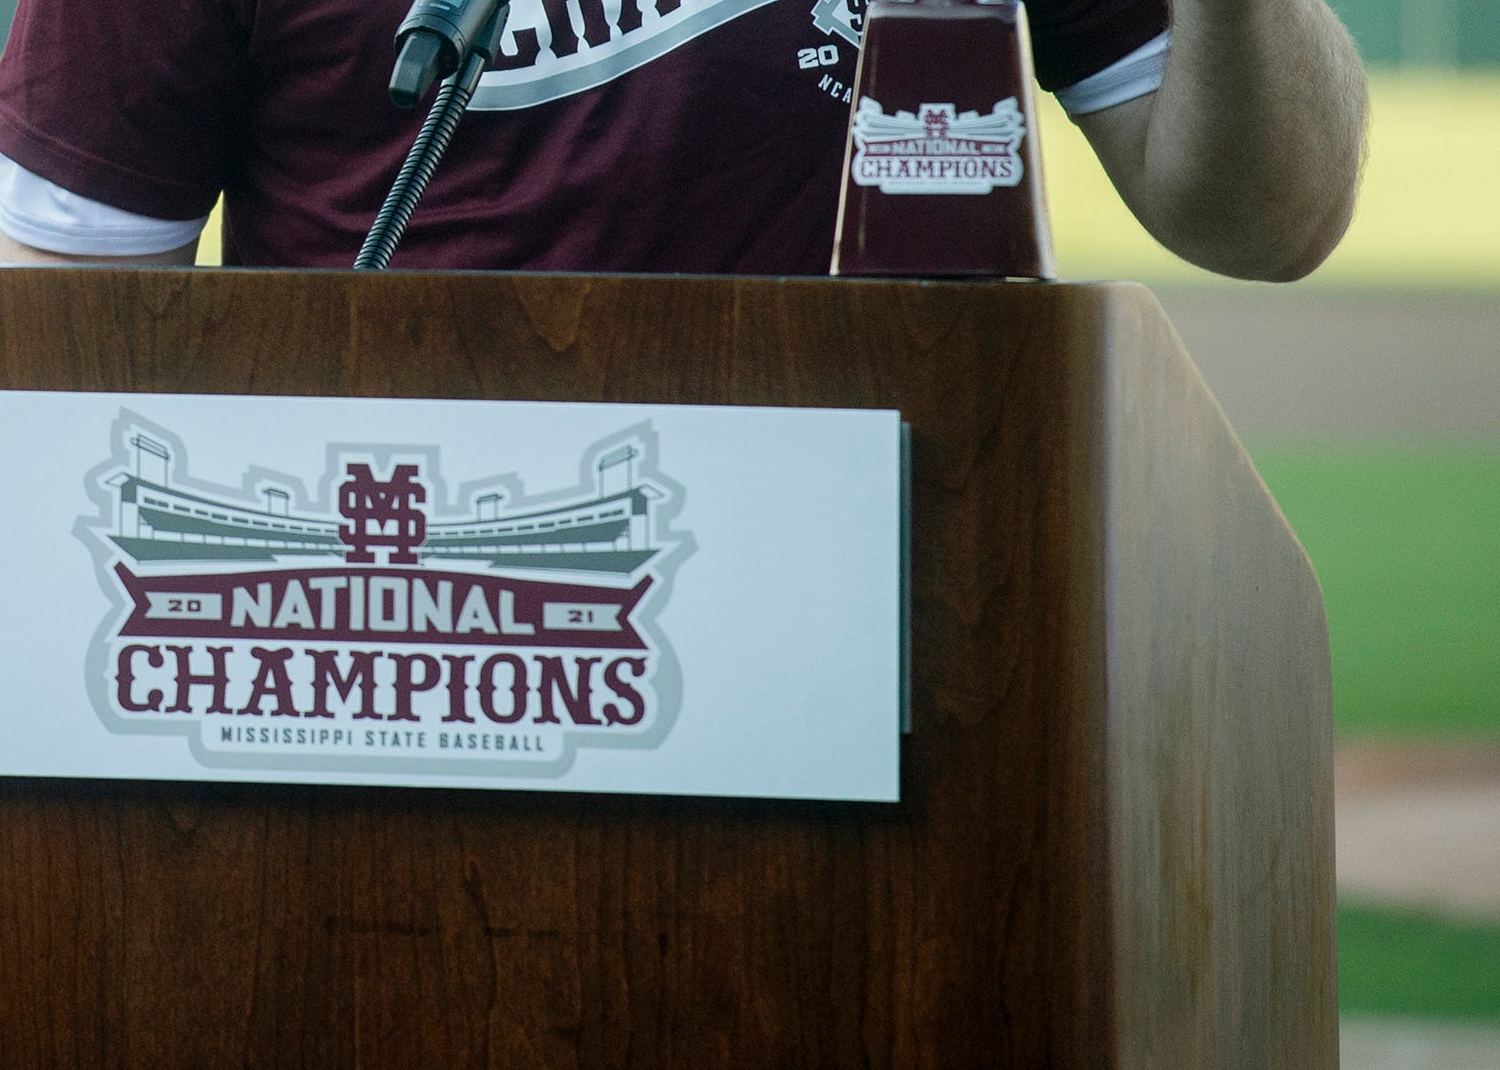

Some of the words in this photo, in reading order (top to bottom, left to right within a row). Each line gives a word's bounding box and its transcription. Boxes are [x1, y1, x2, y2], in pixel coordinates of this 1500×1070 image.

[797, 44, 840, 70] 20
[818, 74, 853, 104] NCA
[892, 139, 981, 155] NATIONAL
[861, 159, 1012, 179] CHAMPIONS
[168, 599, 202, 613] 20
[229, 576, 535, 635] NATIONAL
[567, 609, 595, 624] 21
[114, 644, 648, 728] CHAMPIONS
[221, 727, 353, 747] MISSISSIPPI
[365, 732, 427, 749] STATE
[439, 734, 545, 752] BASEBALL
